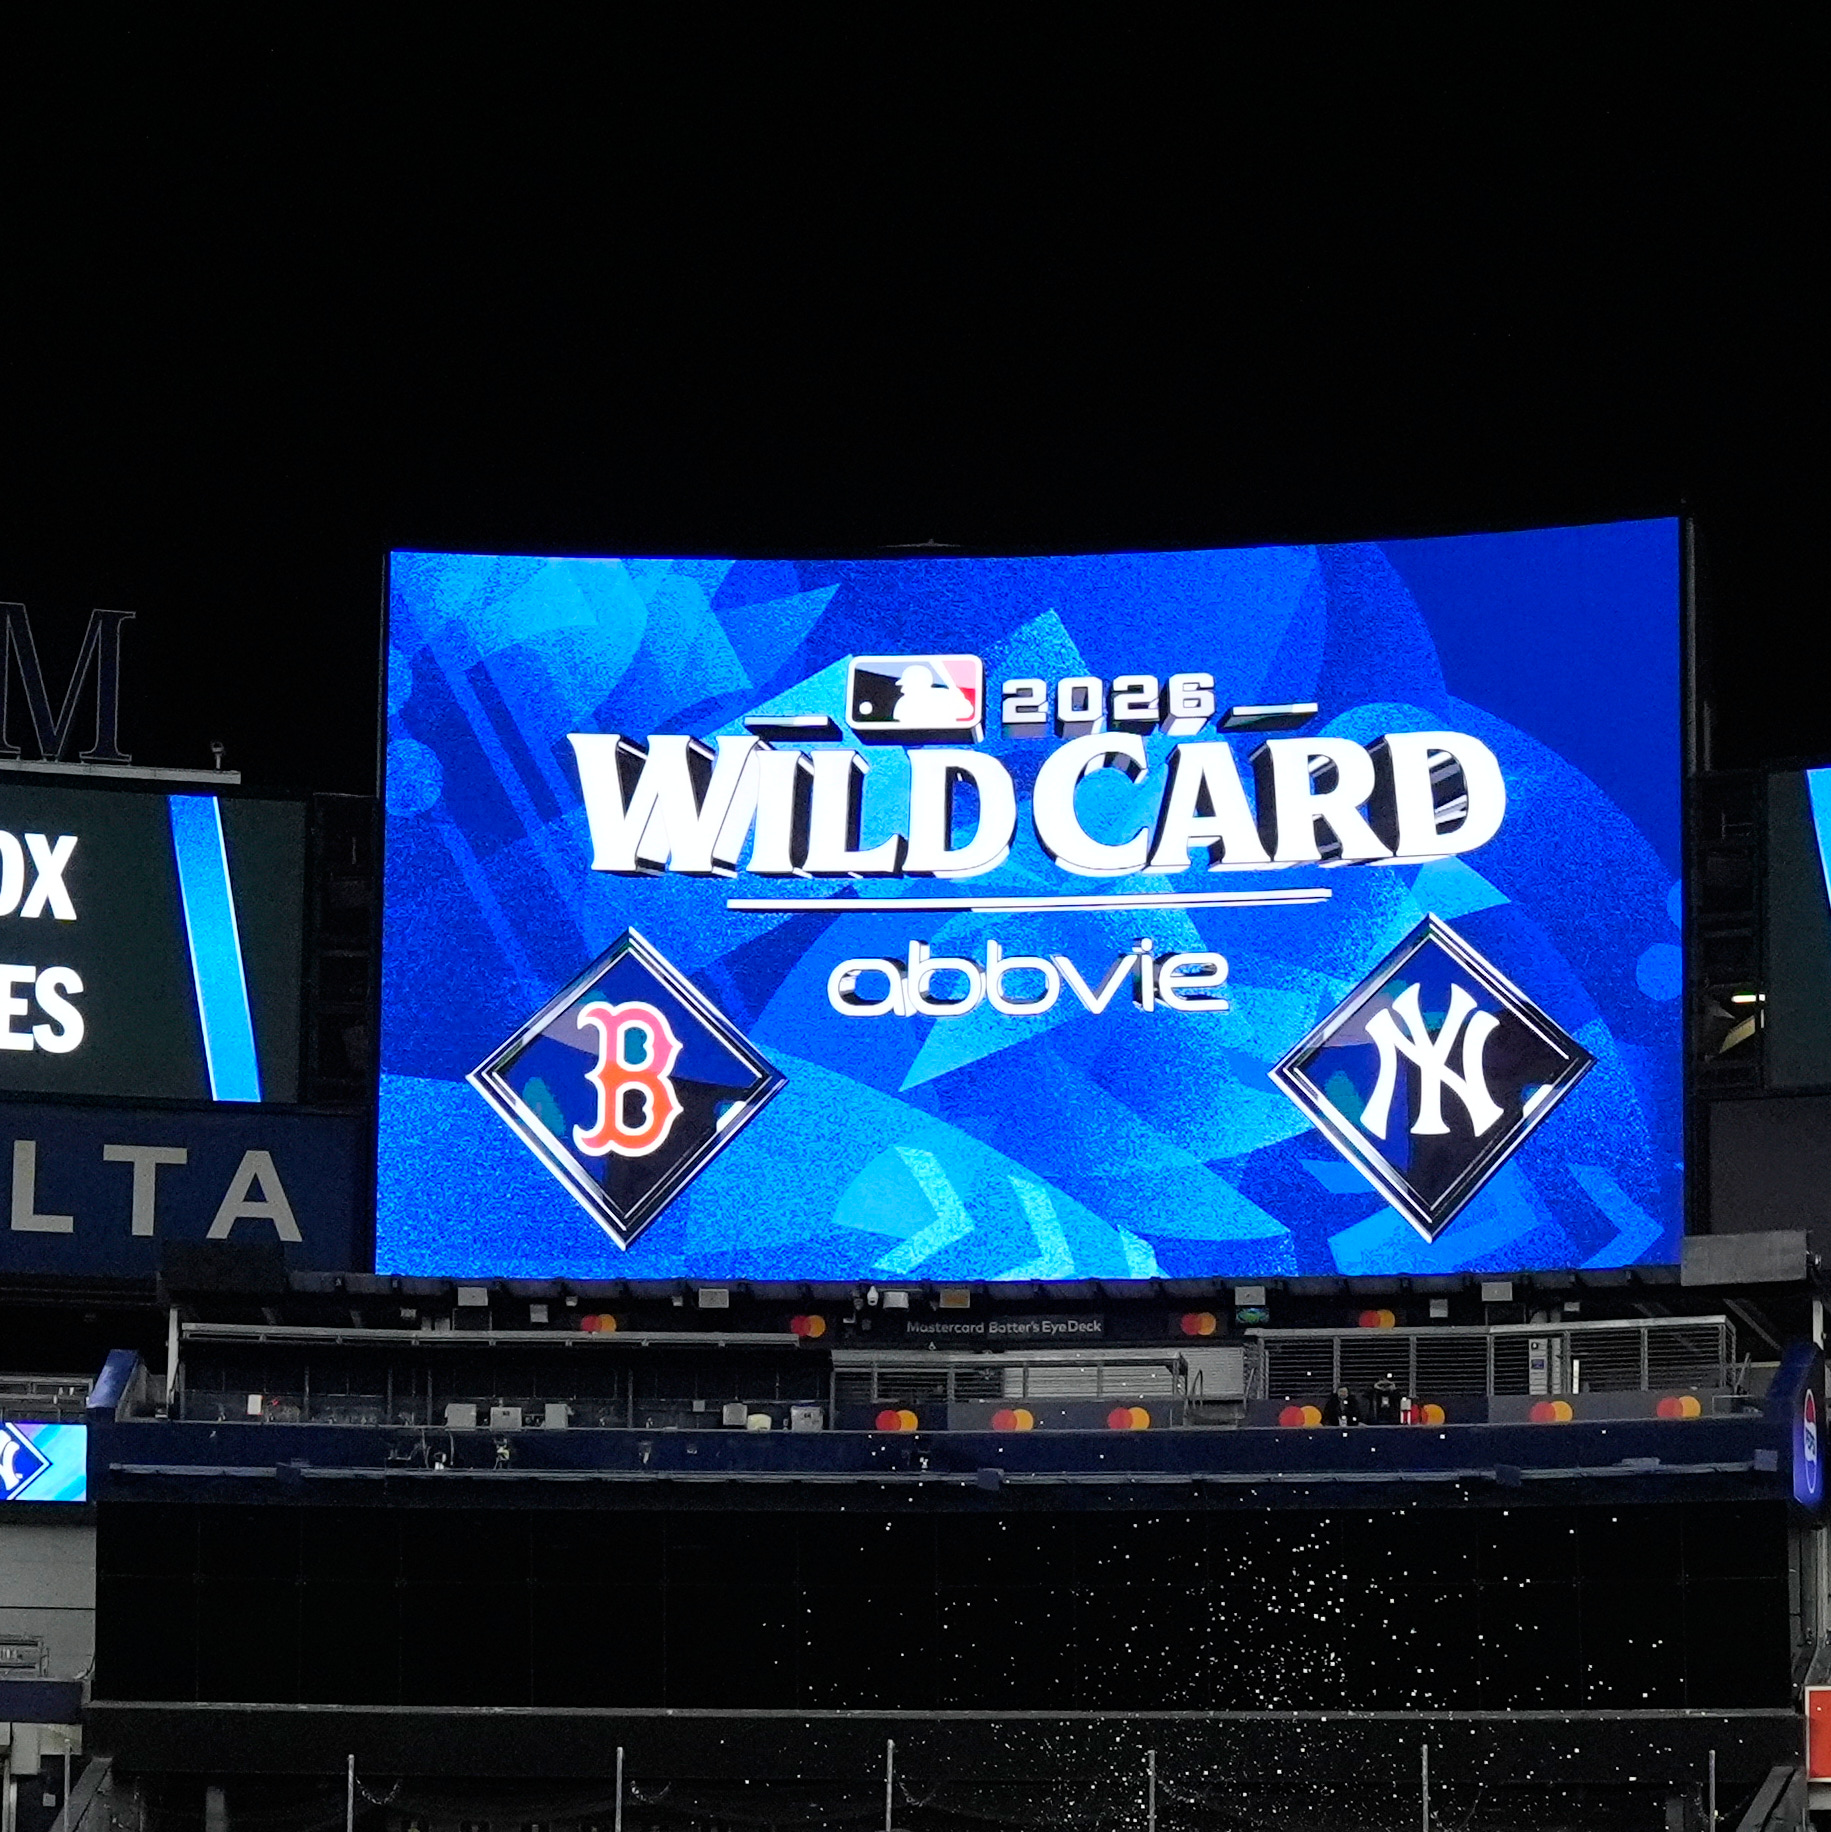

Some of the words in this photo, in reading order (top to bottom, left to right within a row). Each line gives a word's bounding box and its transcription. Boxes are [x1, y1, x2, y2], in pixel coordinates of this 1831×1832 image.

[1001, 672, 1216, 738] 2026
[826, 937, 1231, 1018] abbvie
[906, 1320, 985, 1334] Mastercard
[988, 1320, 1040, 1334] Batter's
[1042, 1320, 1067, 1335] Eye
[1067, 1319, 1102, 1333] Deck
